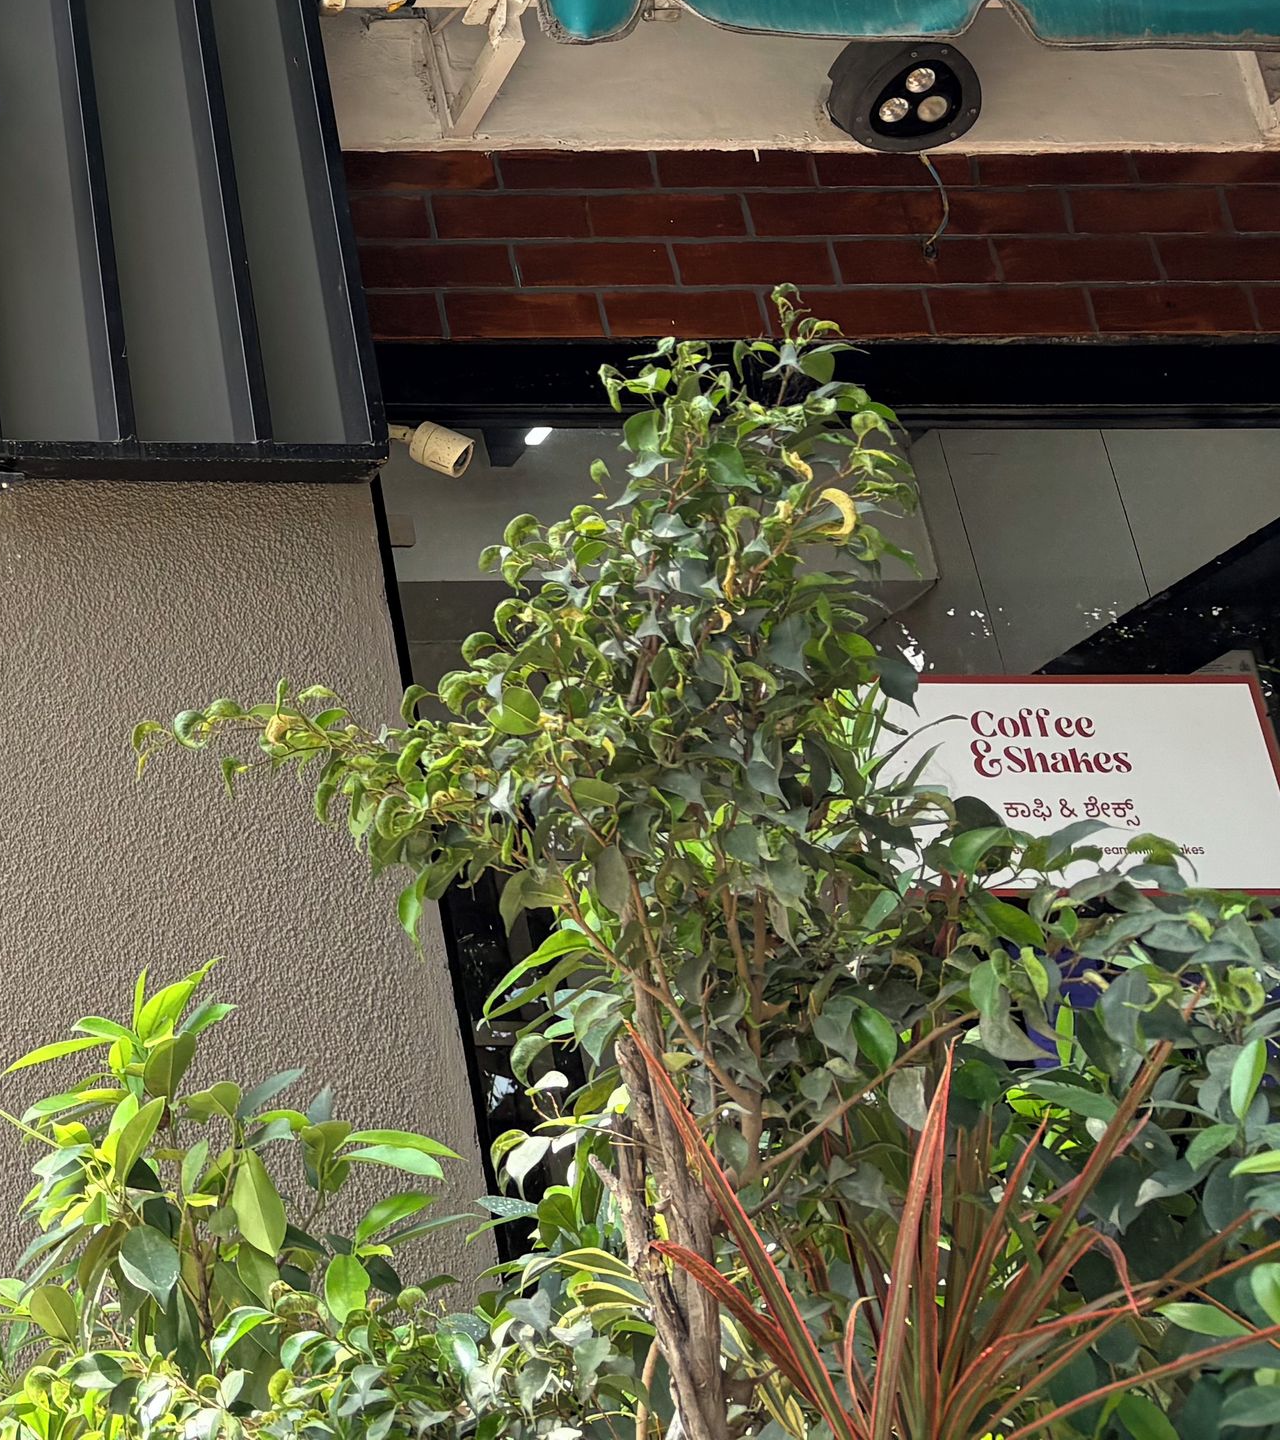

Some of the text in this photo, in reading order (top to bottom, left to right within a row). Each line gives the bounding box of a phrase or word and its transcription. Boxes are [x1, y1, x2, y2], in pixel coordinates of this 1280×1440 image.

[970, 708, 1096, 738] Coffee
[1003, 798, 1052, 821] ಕಾಫಿ
[1059, 798, 1078, 818] &
